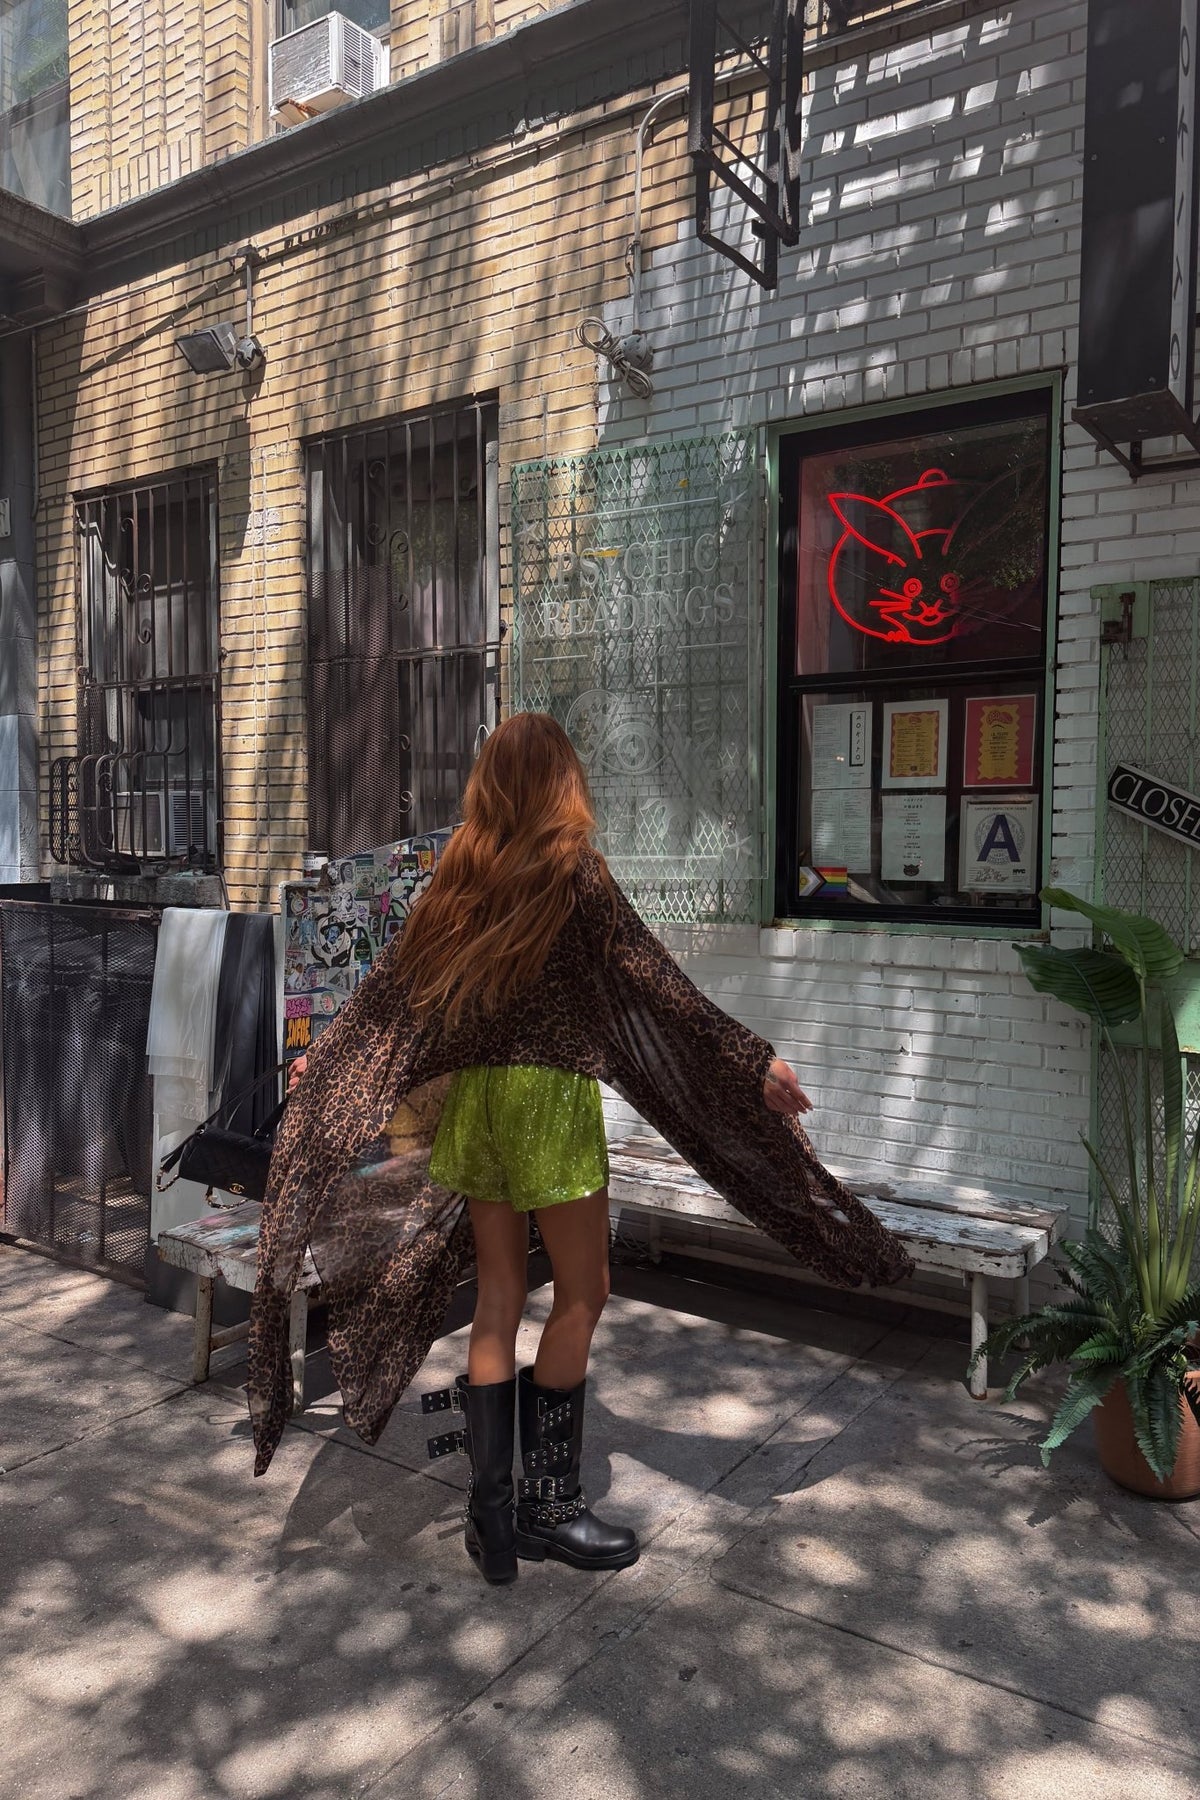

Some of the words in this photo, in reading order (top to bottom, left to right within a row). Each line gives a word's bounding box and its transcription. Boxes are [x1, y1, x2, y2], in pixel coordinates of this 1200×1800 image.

[1171, 25, 1190, 380] OKITO
[553, 533, 719, 590] PSYCHIC
[540, 583, 736, 639] READINGS
[976, 814, 1021, 862] A
